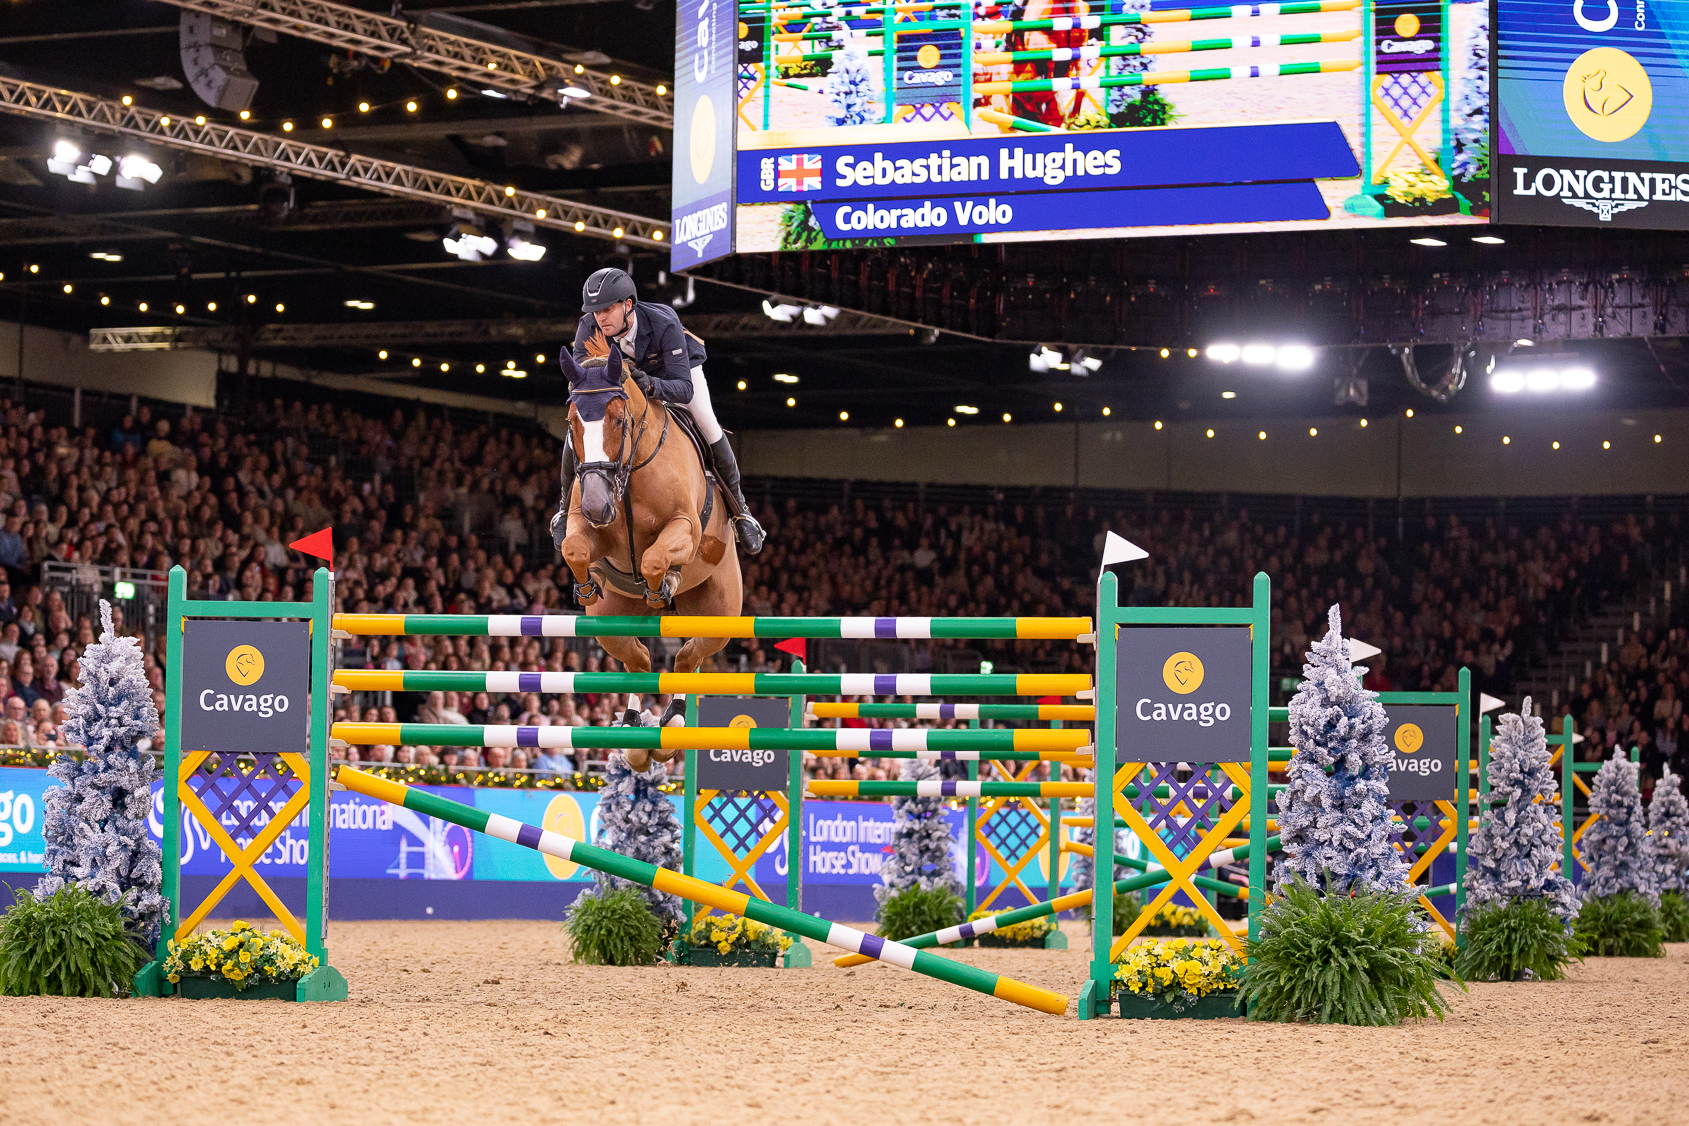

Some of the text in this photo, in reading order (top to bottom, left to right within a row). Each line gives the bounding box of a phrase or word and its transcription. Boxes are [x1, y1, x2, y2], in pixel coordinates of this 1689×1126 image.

[903, 70, 954, 86] Cavago
[760, 156, 775, 192] GBR
[835, 143, 1122, 187] Sebastian Hughes
[674, 201, 728, 245] LONGINES
[835, 198, 1013, 231] Colorado Volo
[199, 689, 289, 718] Cavago
[1135, 698, 1231, 727] Cavago
[709, 749, 775, 767] Cavago
[1387, 758, 1442, 777] avago
[809, 812, 858, 843] London
[808, 844, 883, 875] Horse Show
